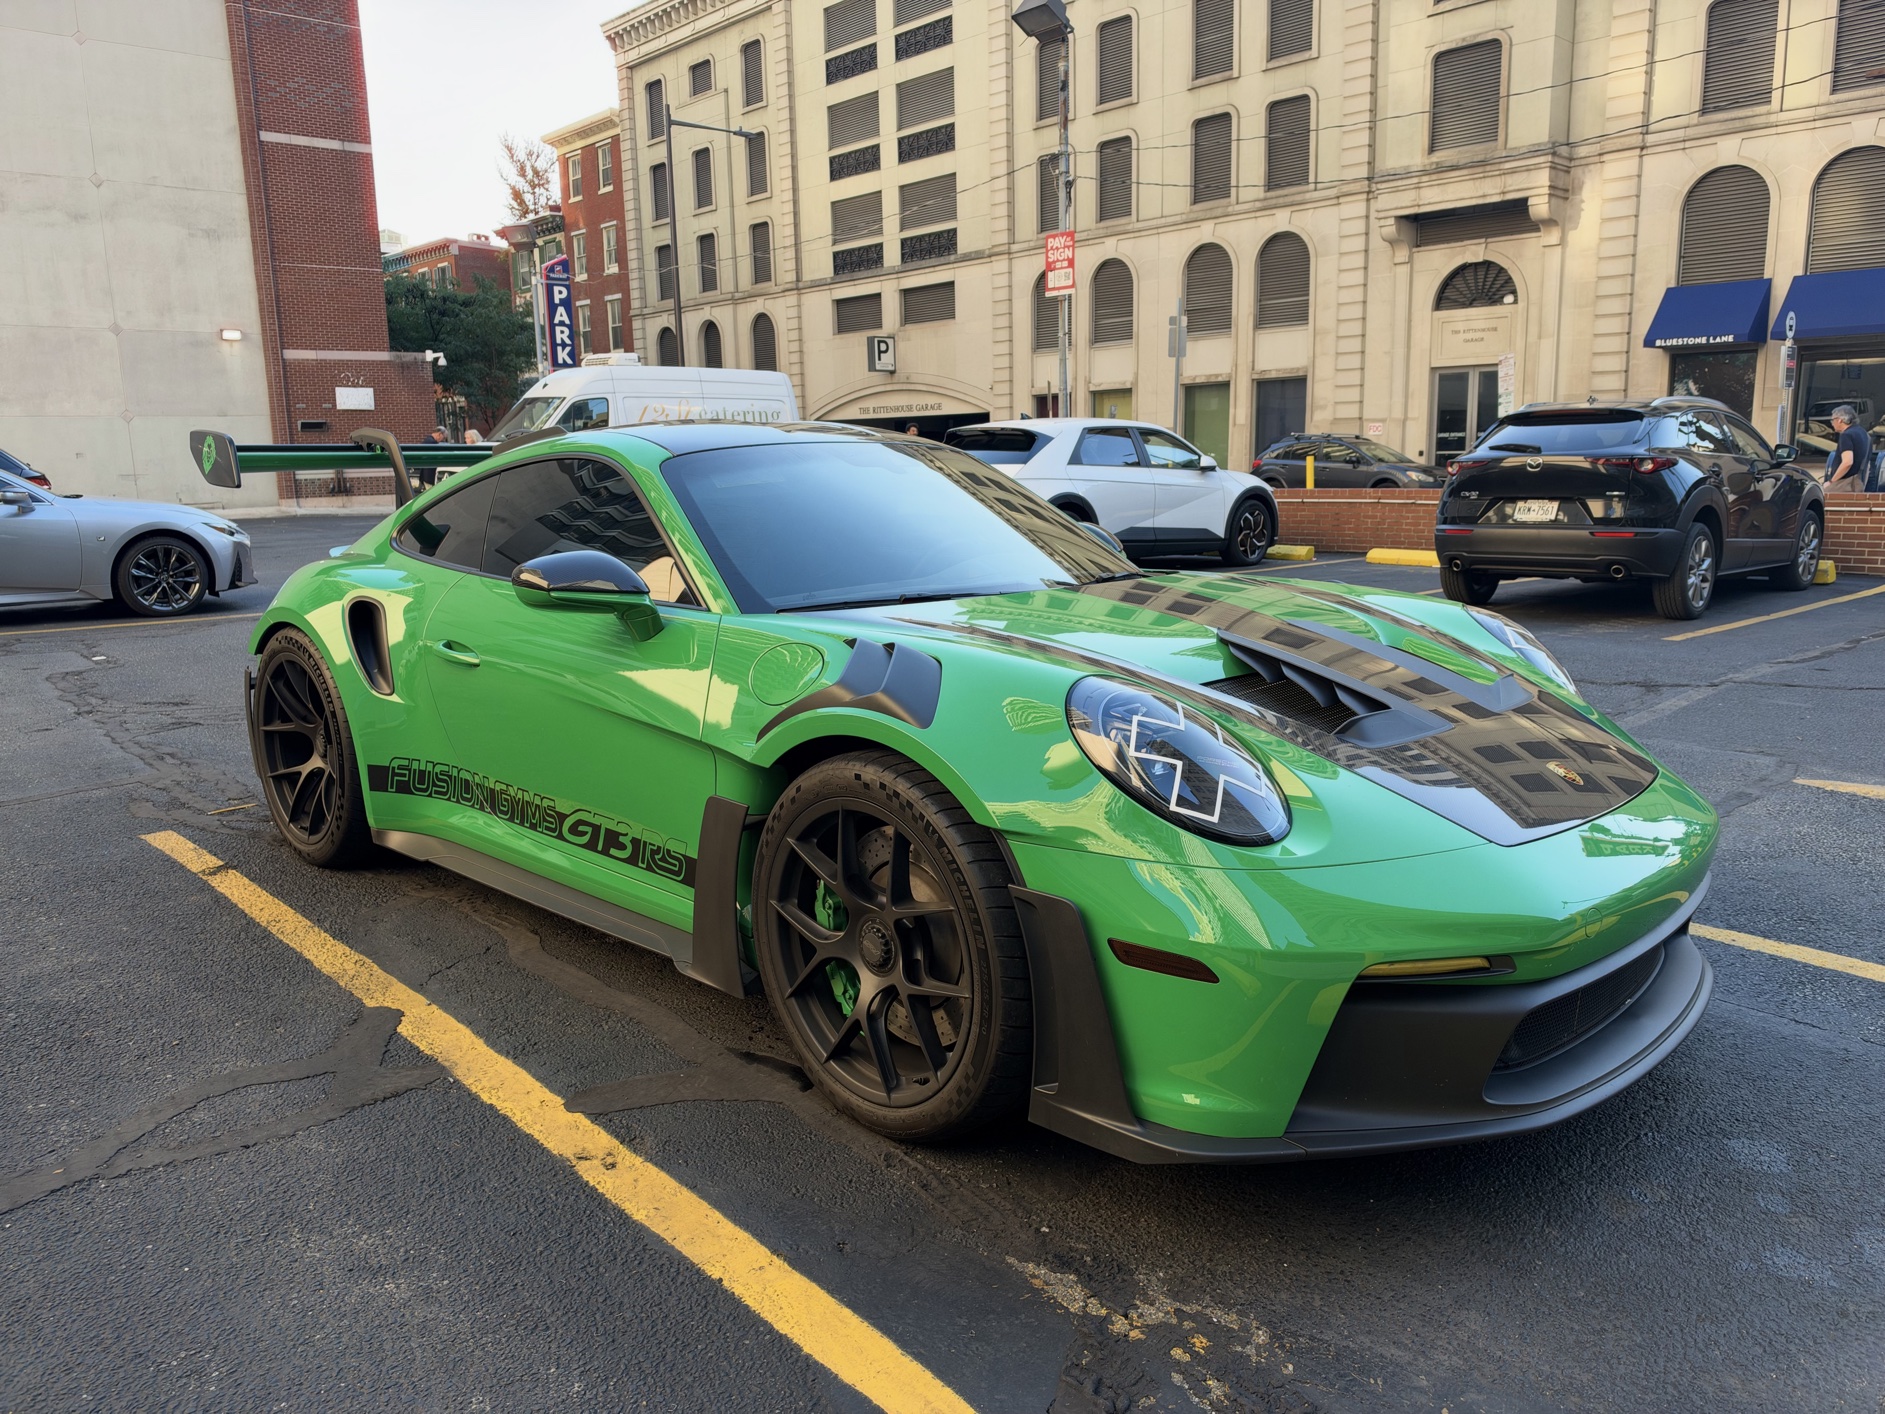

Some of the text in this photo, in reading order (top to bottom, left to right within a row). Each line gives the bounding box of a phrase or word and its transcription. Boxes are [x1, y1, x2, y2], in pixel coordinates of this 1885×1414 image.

[1048, 236, 1066, 250] PAY
[1048, 247, 1072, 262] SIGN
[553, 286, 574, 364] PARK
[1655, 335, 1734, 346] BLUESTONE LANE
[877, 340, 890, 361] P
[698, 404, 781, 422] catering
[872, 404, 914, 414] RITTENHOUSE
[916, 403, 942, 412] GARAGE
[310, 658, 334, 712] MICHELIN
[388, 756, 688, 882] FUSION GYMS GT3 RS
[938, 846, 986, 950] MICHELIN
